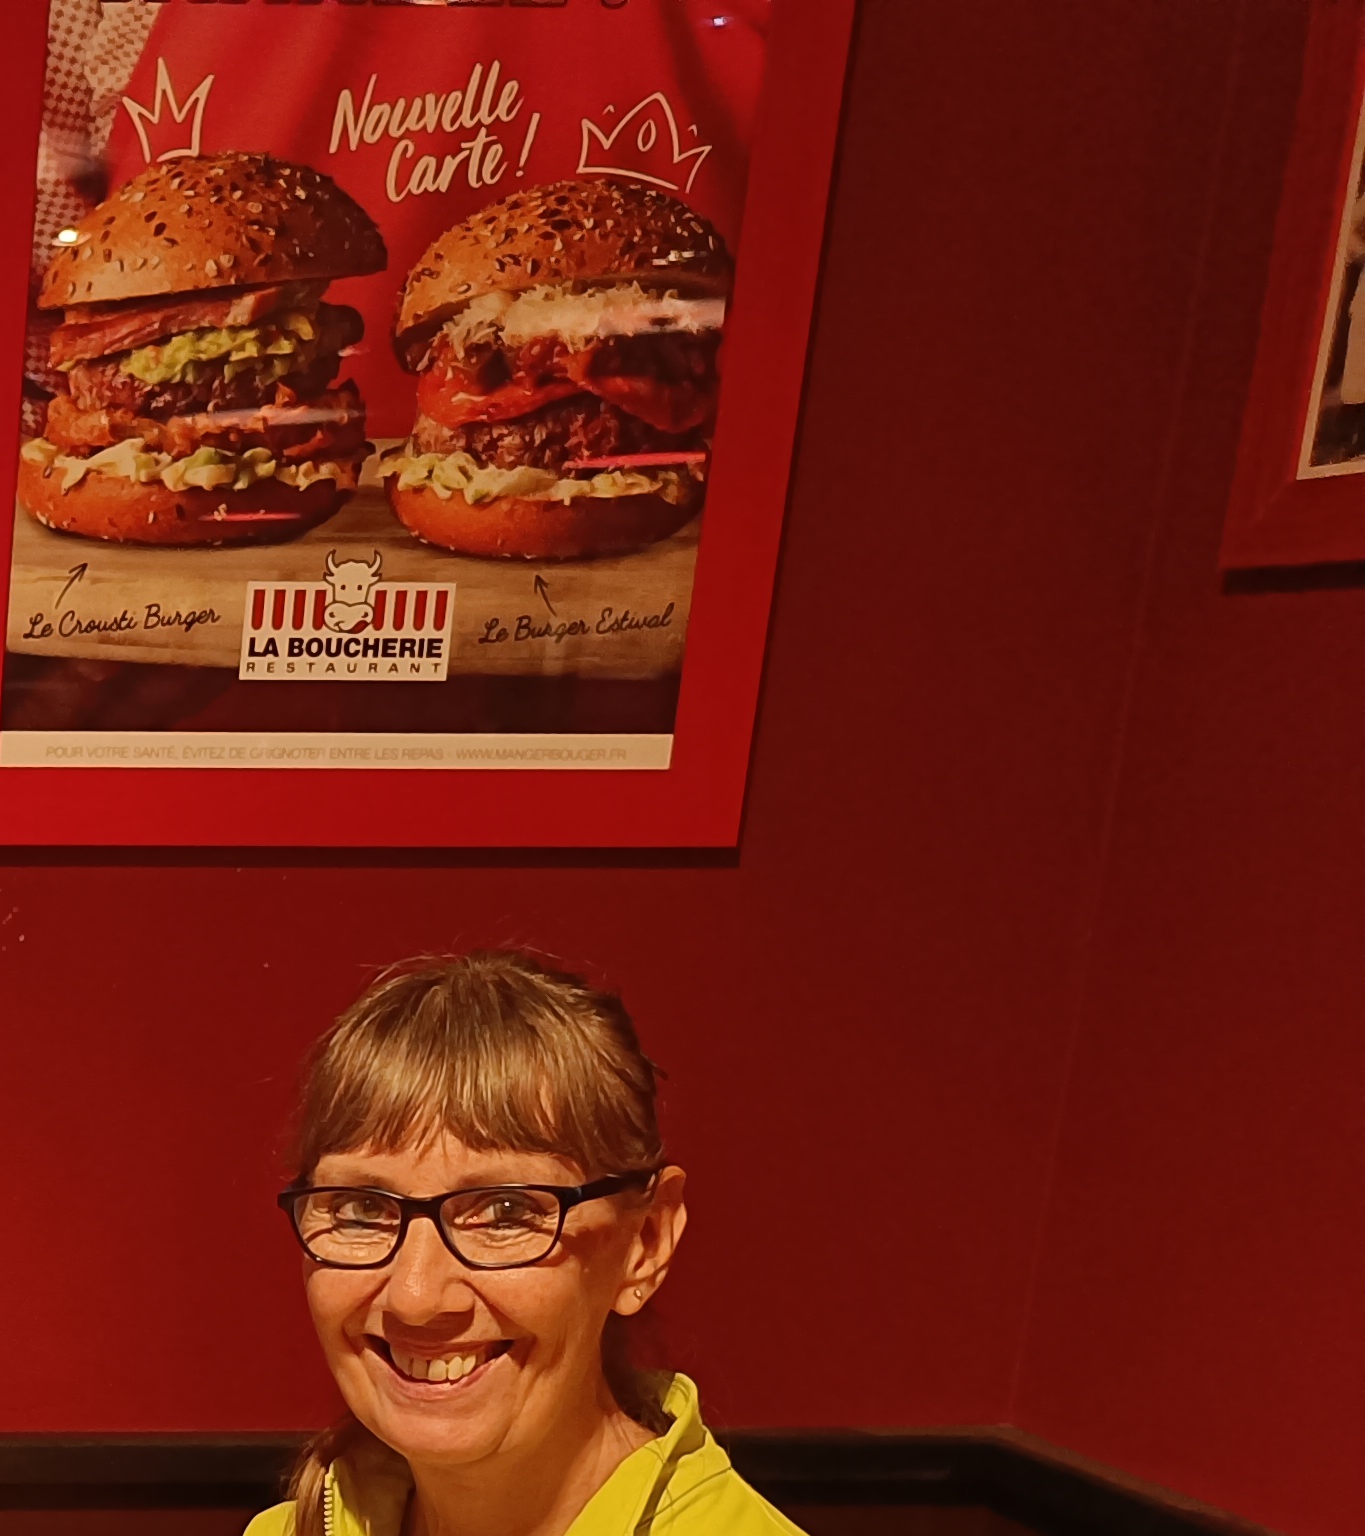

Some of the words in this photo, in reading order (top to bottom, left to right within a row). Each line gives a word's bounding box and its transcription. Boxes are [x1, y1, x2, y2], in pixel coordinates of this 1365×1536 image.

[330, 59, 524, 153] Nouvelle
[387, 141, 510, 202] Carte
[23, 613, 54, 638] Le
[59, 610, 137, 637] Crousti
[144, 603, 221, 632] Burger
[478, 617, 509, 644] Le
[514, 615, 591, 643] Burger
[596, 602, 675, 635] Estival
[248, 637, 279, 657] LA
[287, 637, 443, 659] BOUCHERIE
[246, 661, 442, 674] RESTAURANT
